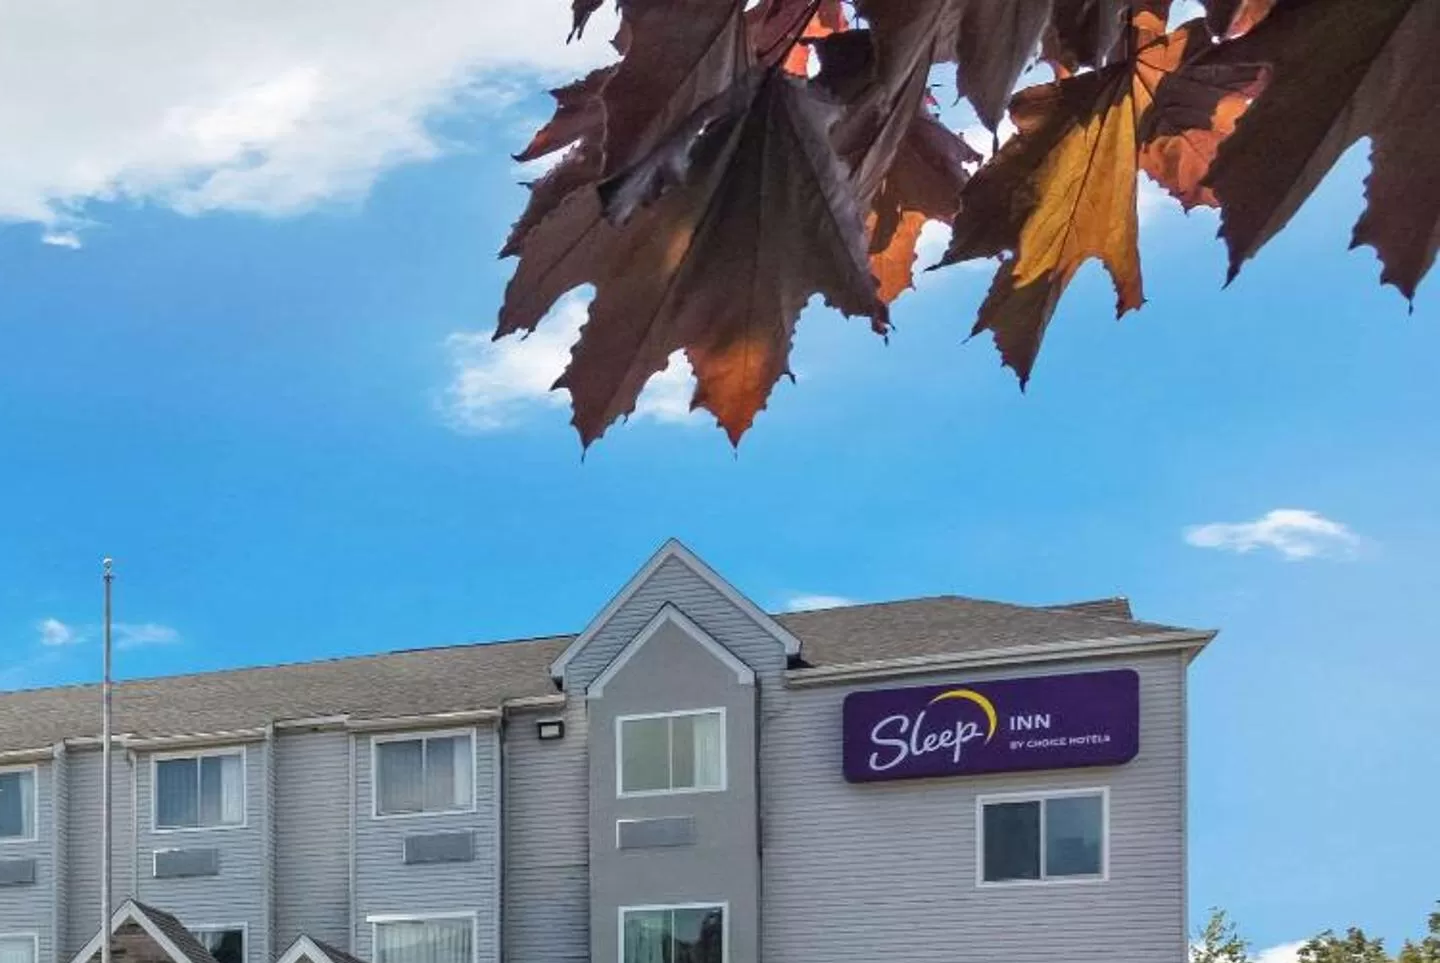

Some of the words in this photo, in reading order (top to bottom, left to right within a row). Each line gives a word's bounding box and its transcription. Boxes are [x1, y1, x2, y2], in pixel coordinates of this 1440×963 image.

[869, 710, 984, 771] Sleep
[1010, 714, 1051, 731] INN
[1009, 740, 1024, 750] BY
[1026, 737, 1068, 748] CHOICE
